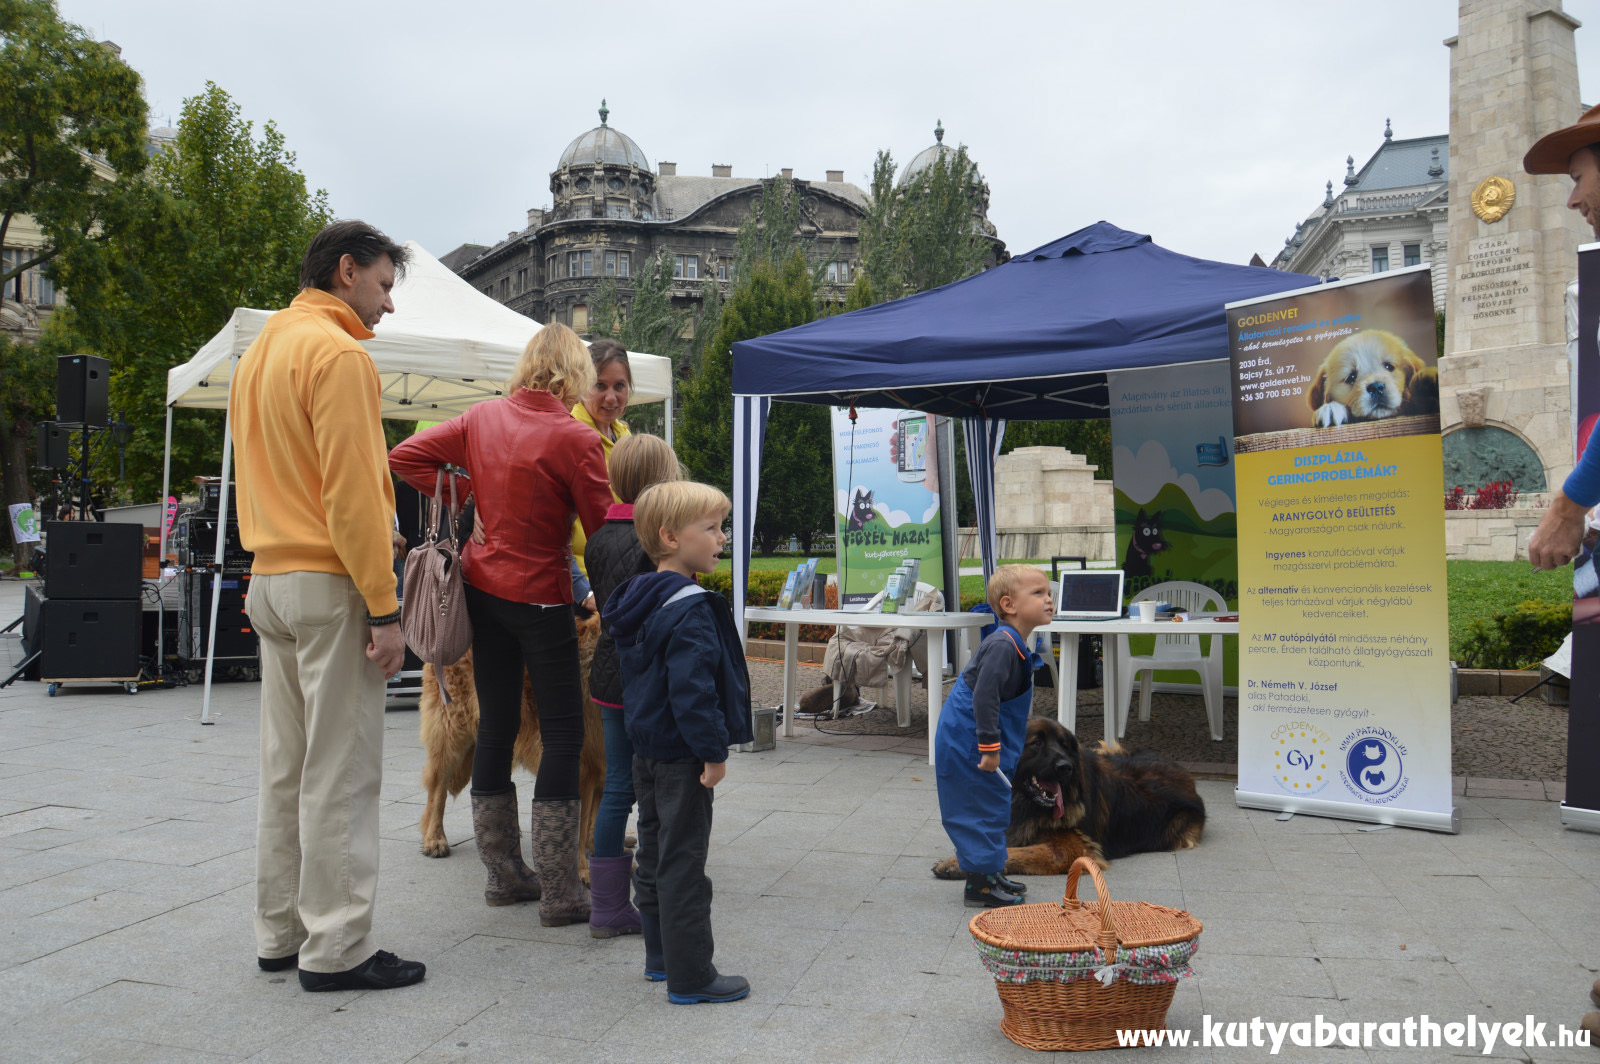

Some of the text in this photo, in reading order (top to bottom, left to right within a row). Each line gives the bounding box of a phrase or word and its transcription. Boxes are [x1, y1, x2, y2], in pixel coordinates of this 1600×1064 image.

[1478, 240, 1508, 250] СЛАВА
[1468, 247, 1520, 260] СОВЕТСКИМ
[1477, 299, 1513, 309] SZOVJET
[1237, 308, 1299, 328] GOLDENVET
[1283, 318, 1318, 333] rendelő
[1320, 318, 1330, 327] és
[1332, 313, 1362, 326] patika
[1243, 342, 1260, 352] ahol
[1262, 336, 1304, 349] természetes
[1239, 359, 1257, 370] 2030
[1239, 370, 1263, 380] Bajcsy
[1277, 366, 1284, 375] út
[1286, 365, 1297, 374] 77.
[1240, 375, 1311, 391] www.goldenvet.hu
[1170, 390, 1181, 398] az
[1240, 387, 1302, 402] +36 30 700 50 30
[1154, 402, 1165, 412] és
[839, 427, 883, 437] MOBITELEFONOS
[843, 441, 880, 451] KUYAKERESŐ
[1294, 450, 1368, 467] DISZPLÁZIA,
[1267, 464, 1398, 486] GERINCPROBLÉMÁK?
[1258, 495, 1300, 508] Végleges
[1301, 495, 1312, 504] és
[1359, 488, 1410, 502] megoldás:
[1272, 504, 1396, 522] ARANYGOLYÓ BEÜLTETÉS
[1269, 524, 1345, 536] Magyarországon
[1347, 523, 1369, 532] csak
[1372, 520, 1406, 531] nálunk.
[892, 528, 930, 546] HAZA!
[1265, 545, 1405, 561] Ingyenes konzultációval várjuk
[1273, 558, 1397, 573] mozgásszervi problémákra.
[1301, 586, 1311, 594] és
[1313, 584, 1382, 594] konvencionális
[1385, 583, 1432, 593] kezelések
[1262, 596, 1413, 609] teljes tárházával várjuk négylábú
[1302, 609, 1369, 618] kedvenceiket.
[1279, 633, 1337, 644] autópályától
[1339, 635, 1388, 644] mindössze
[1390, 635, 1428, 646] néhány
[1281, 644, 1307, 654] Érden
[1309, 645, 1351, 655] található
[1353, 646, 1433, 658] állatgyógyászati
[1308, 658, 1365, 668] központunk.
[1248, 679, 1338, 692] Dr. Németh V. József
[1248, 691, 1267, 700] alias
[1253, 704, 1266, 712] aki
[1267, 704, 1332, 716] természetesen
[1270, 721, 1332, 744] GOLDENVET
